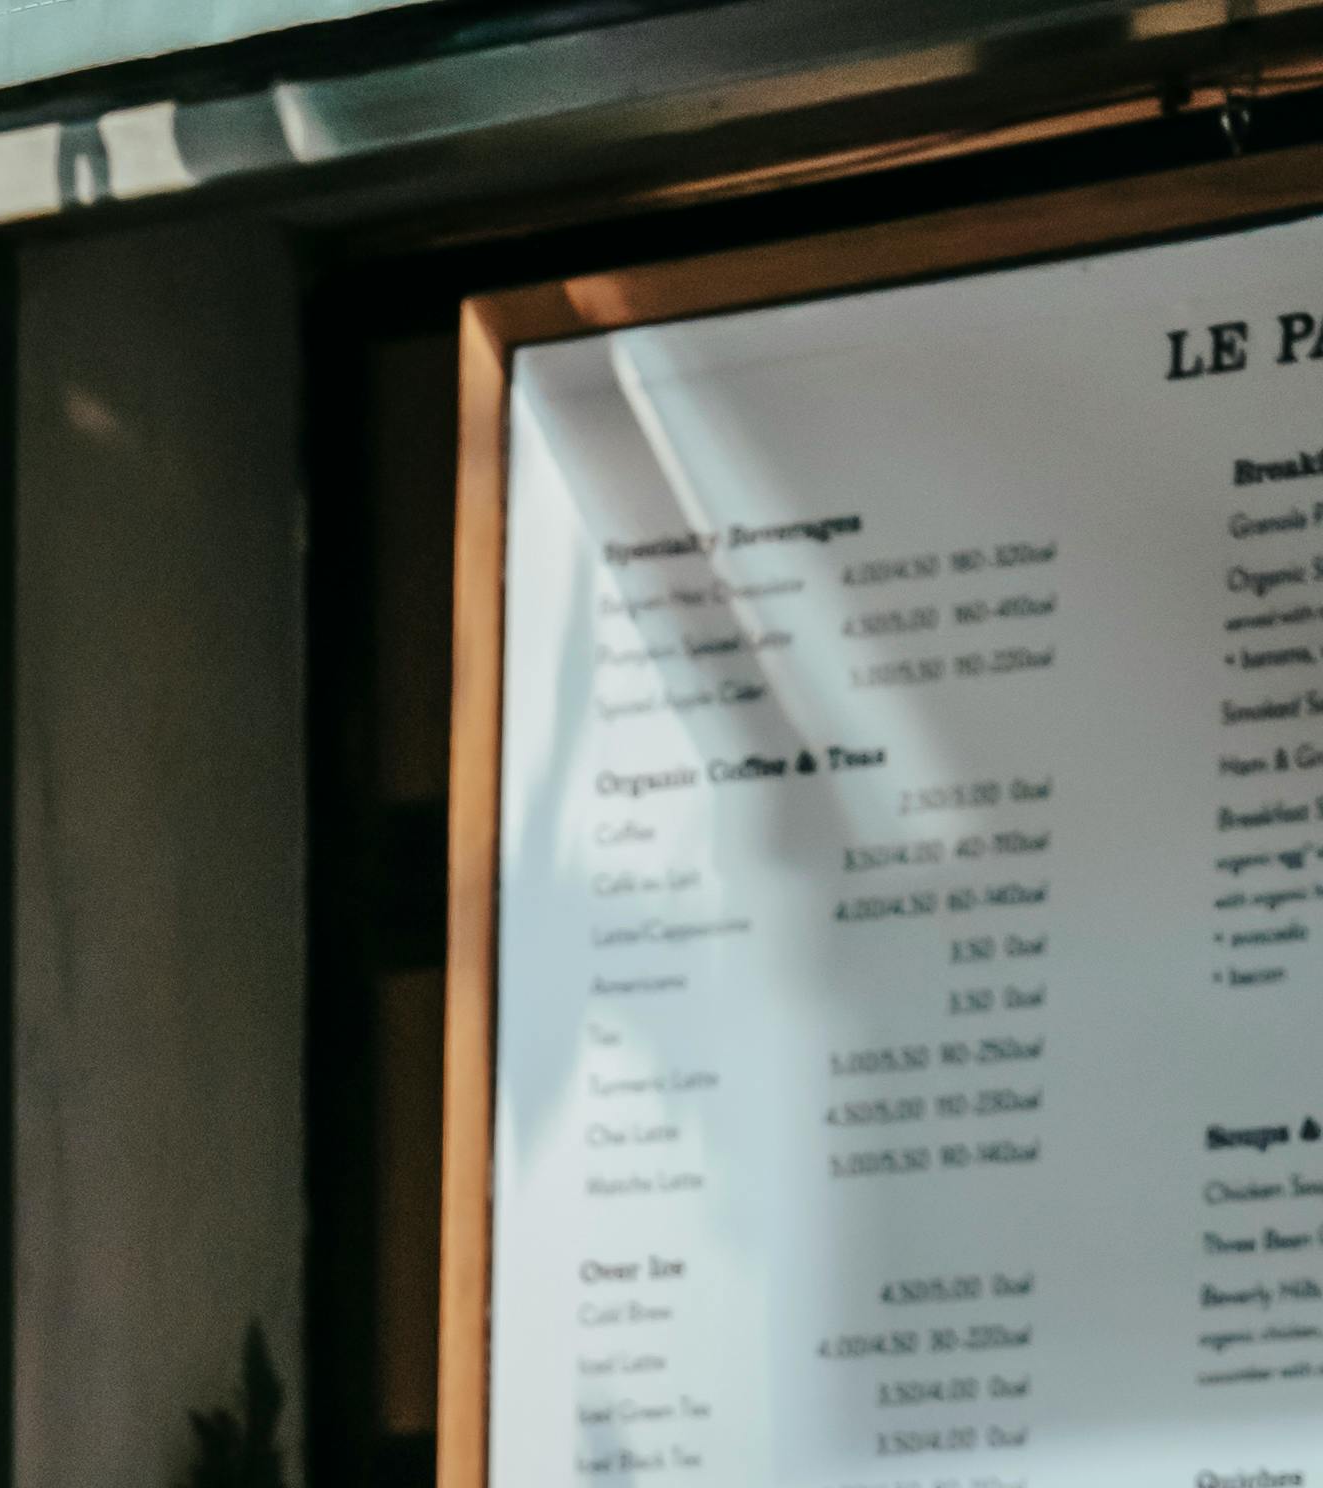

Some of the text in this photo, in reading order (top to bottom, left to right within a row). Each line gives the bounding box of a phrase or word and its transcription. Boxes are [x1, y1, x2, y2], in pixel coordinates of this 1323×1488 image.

[1165, 320, 1249, 382] LE
[729, 515, 862, 548] Beverages
[595, 768, 698, 798] Organic
[708, 752, 786, 783] Coffee
[827, 745, 886, 770] Teas
[578, 1254, 687, 1285] Over Ice
